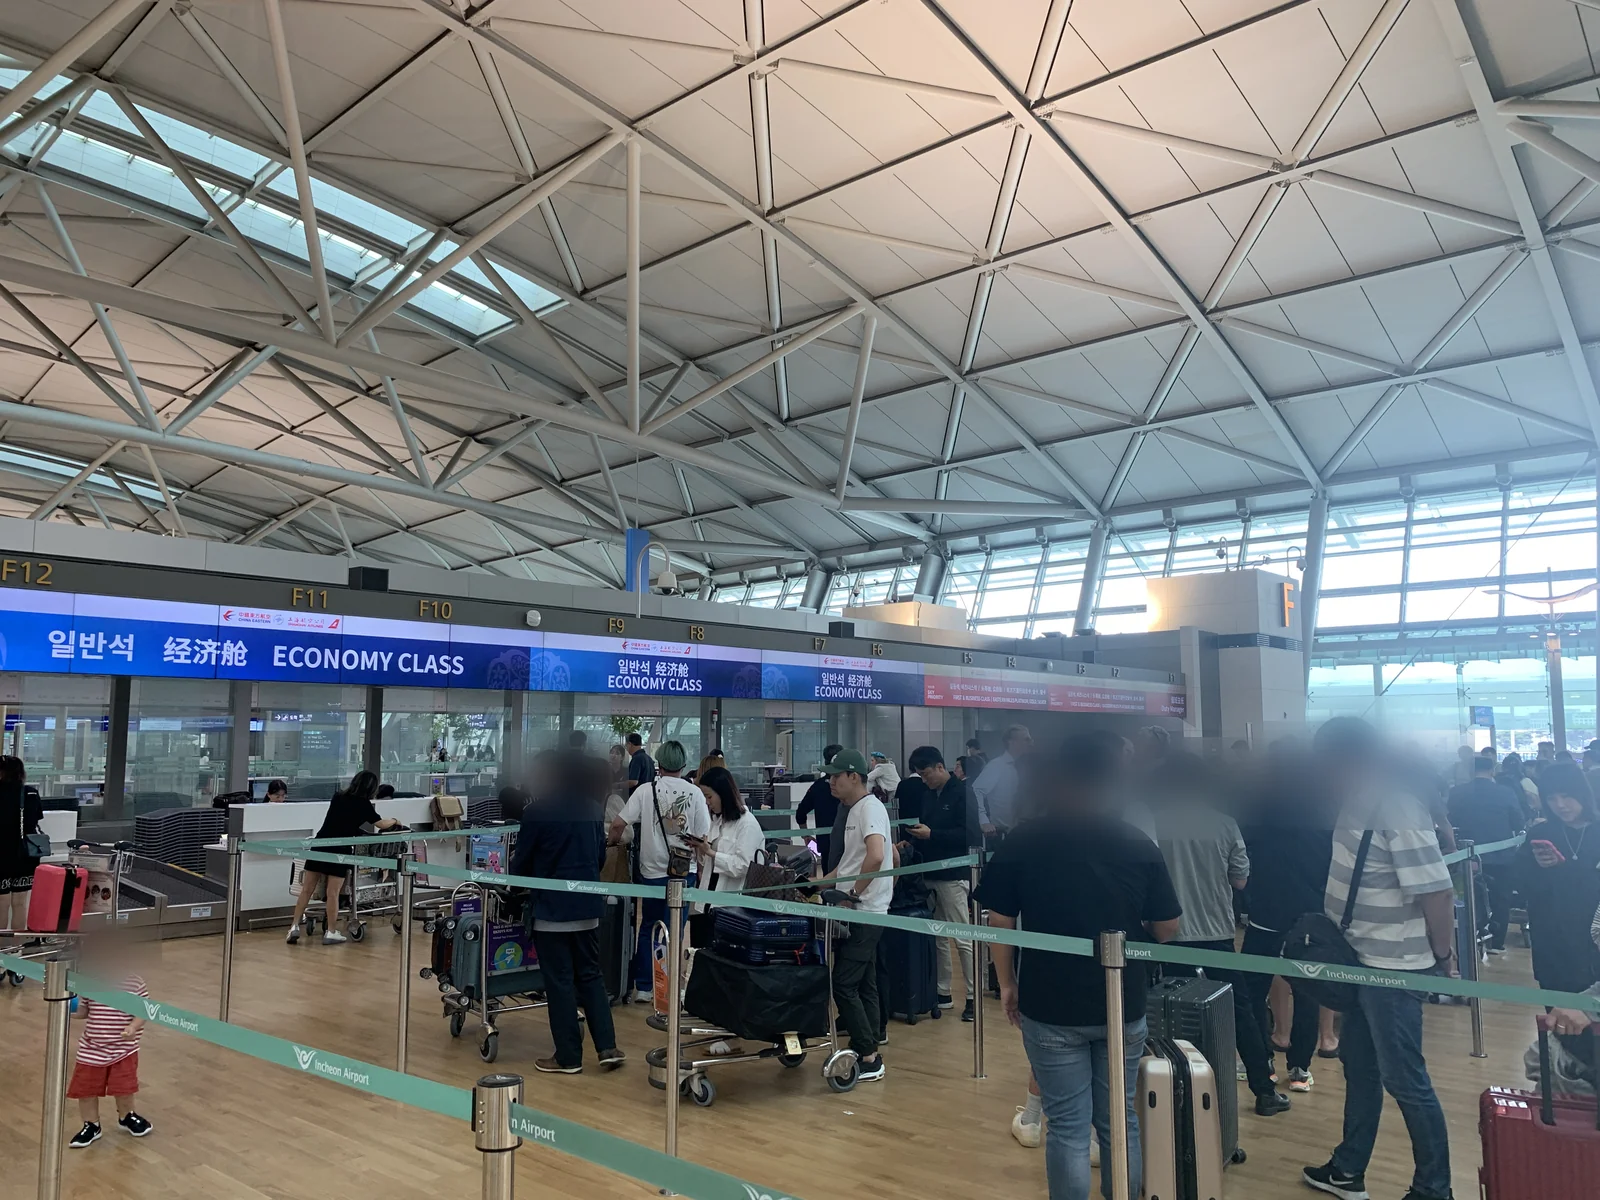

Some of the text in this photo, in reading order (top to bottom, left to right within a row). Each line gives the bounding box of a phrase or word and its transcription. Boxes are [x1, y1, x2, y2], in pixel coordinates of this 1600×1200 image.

[1, 559, 53, 585] F12
[291, 587, 328, 609] F11
[1281, 582, 1294, 627] F
[419, 599, 453, 619] F10
[608, 617, 625, 634] F9
[690, 625, 705, 640] F8
[48, 630, 465, 676] 일반석 经济舱 ECONOMY CLASS
[814, 638, 826, 651] F7
[872, 643, 883, 656] F6
[618, 659, 689, 678] 일반석 经济舱
[608, 675, 702, 692] ECONOMY CLASS
[821, 672, 873, 688] 일반석 经济舱
[814, 686, 882, 700] ECONOMY CLASS
[577, 884, 593, 892] Incheon
[946, 928, 997, 940] Incheon Airport
[1326, 970, 1407, 987] Incheon Airport
[159, 1011, 199, 1032] Incheon Airport
[314, 1059, 370, 1085] Incheon Airport
[520, 1118, 556, 1142] Airport
